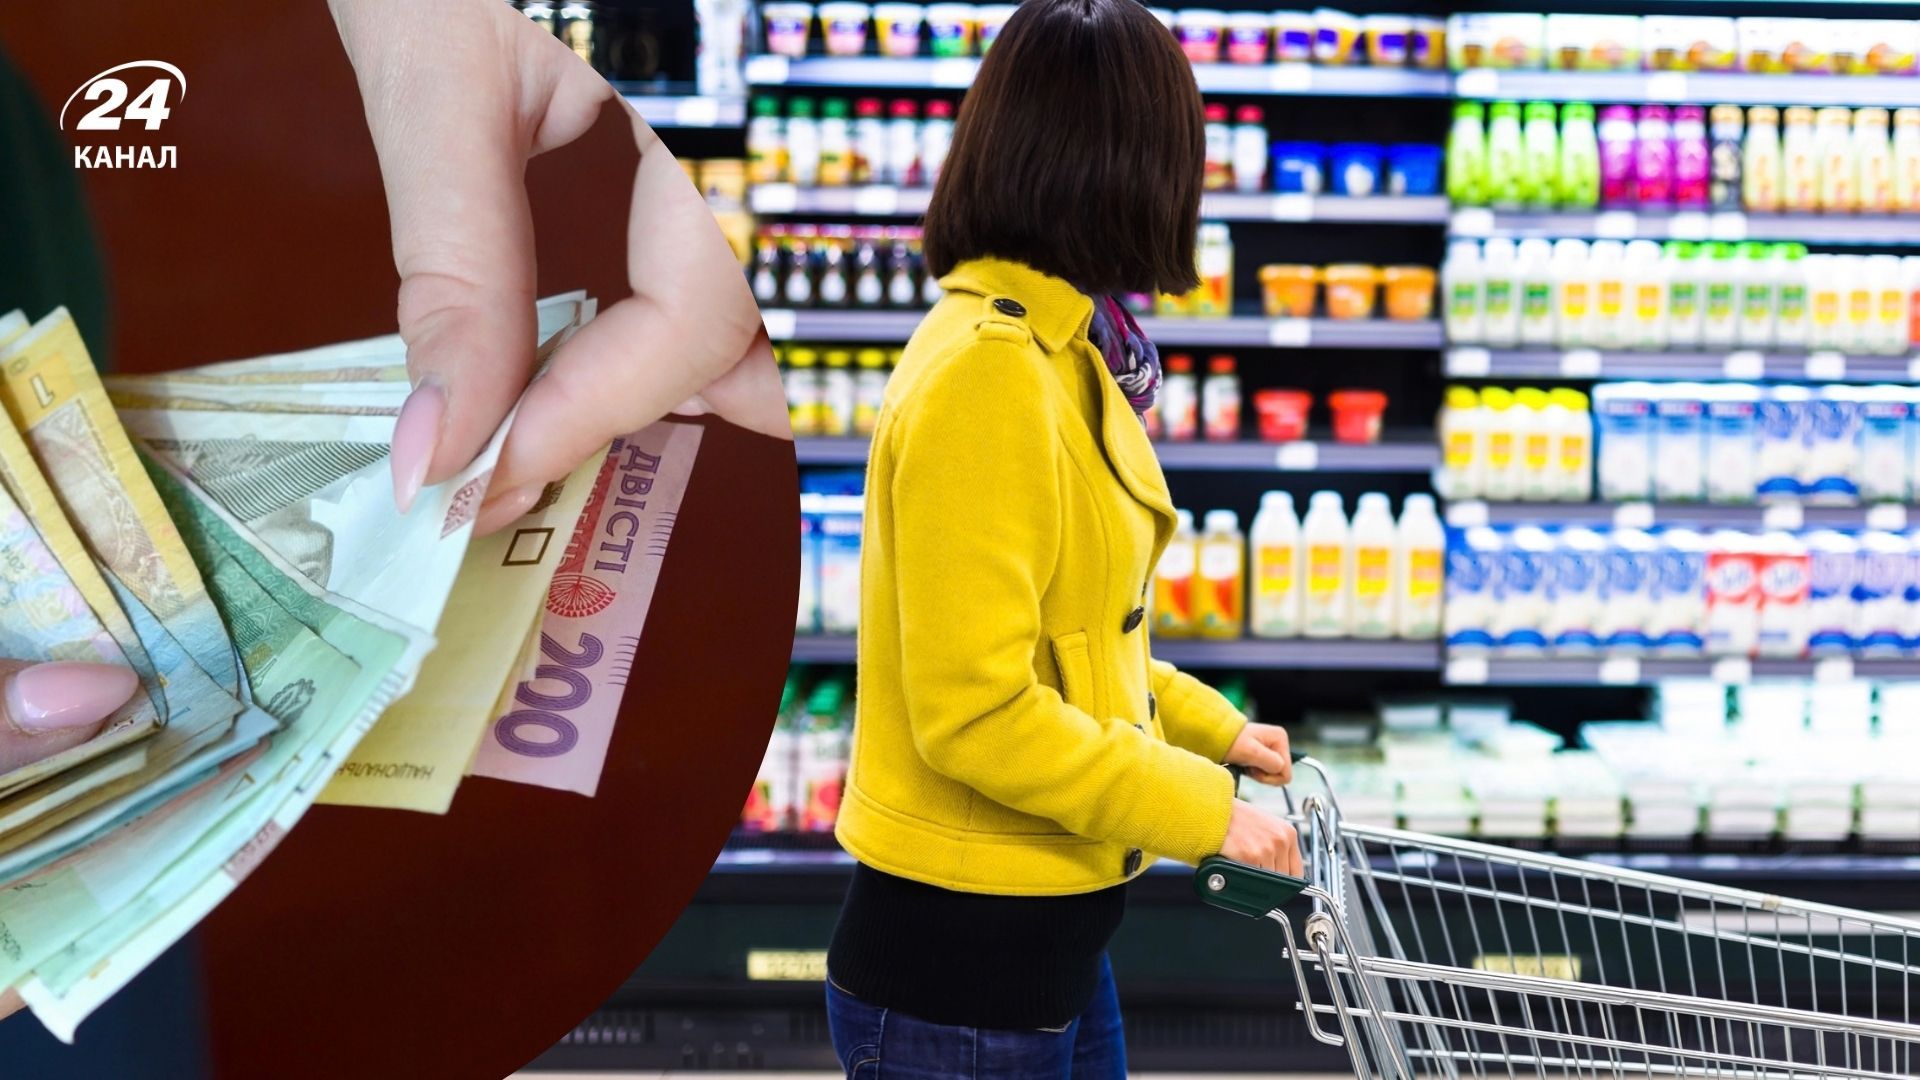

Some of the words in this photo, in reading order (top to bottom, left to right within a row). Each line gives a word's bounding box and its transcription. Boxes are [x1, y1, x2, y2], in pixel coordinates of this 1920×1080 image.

[29, 373, 55, 410] 1
[594, 444, 661, 574] ДВІСТІ
[496, 632, 604, 758] 200
